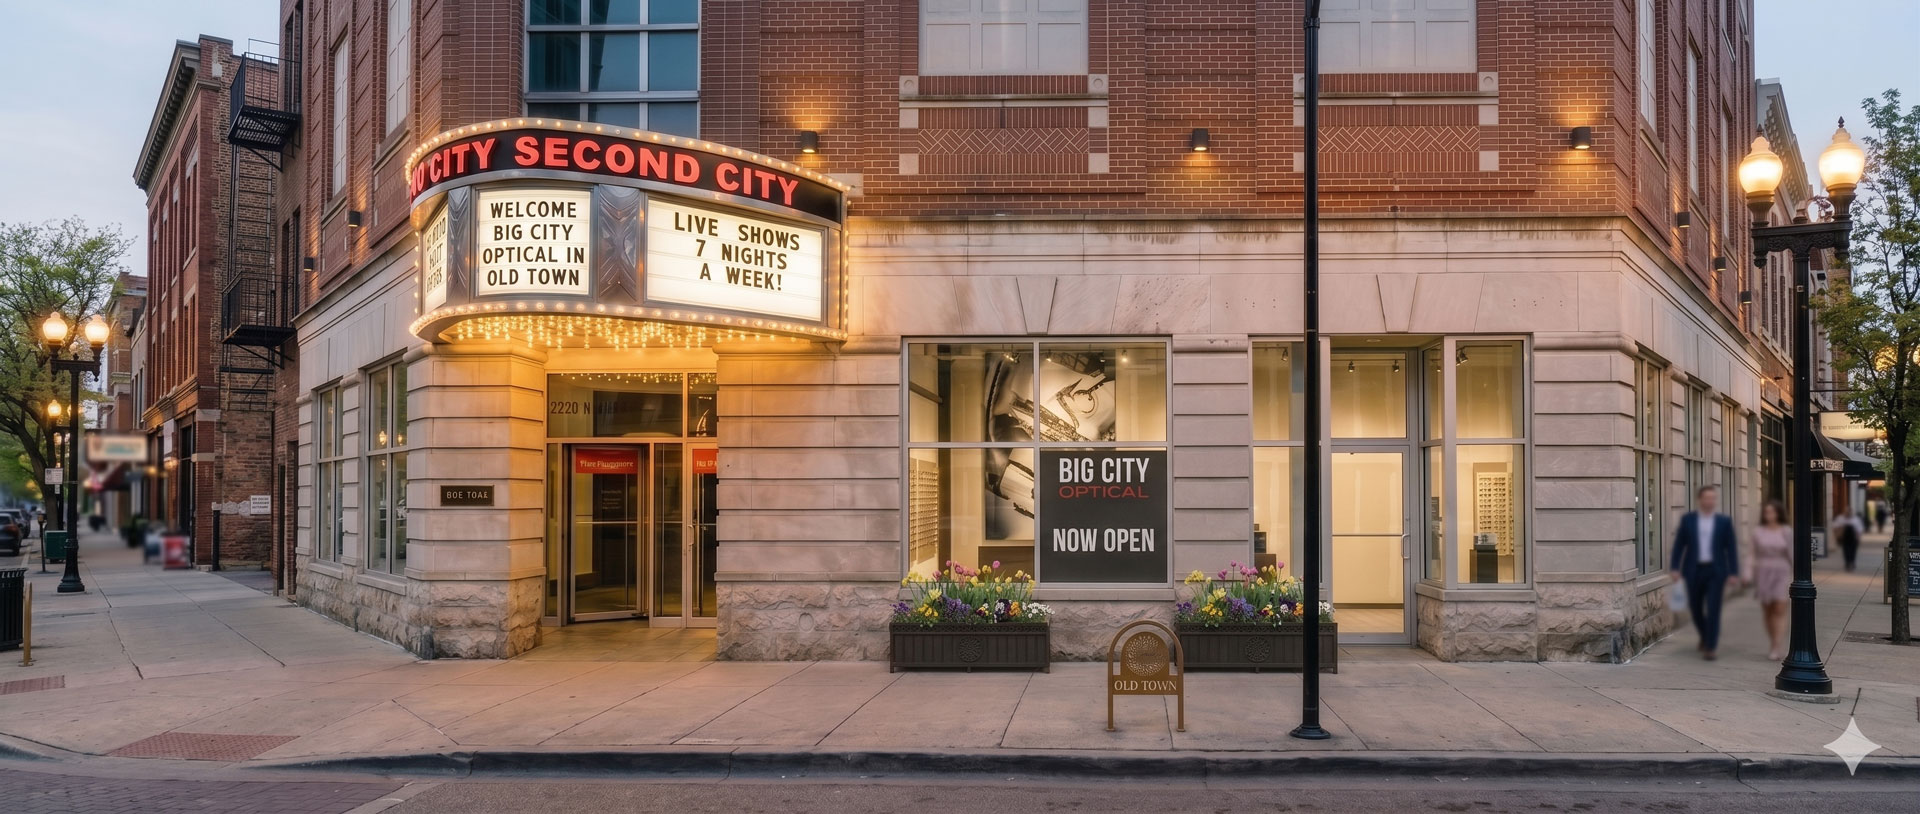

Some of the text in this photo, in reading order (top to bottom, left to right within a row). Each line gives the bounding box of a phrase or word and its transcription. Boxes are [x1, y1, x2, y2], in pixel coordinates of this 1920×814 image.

[430, 138, 496, 183] CITY
[514, 136, 700, 183] SECOND
[715, 162, 799, 206] CITY
[490, 201, 577, 219] WELCOME
[494, 224, 574, 241] BIG CITY
[674, 211, 800, 251] LIVE SHOWS
[482, 246, 585, 264] OPTICAL IN
[696, 238, 787, 270] 7 NIGHTS
[487, 268, 580, 286] OLD TOWN
[699, 262, 782, 291] A WEEK!
[550, 401, 579, 415] 2220
[583, 401, 591, 415] N
[1059, 457, 1150, 483] BIG CITY
[1059, 485, 1149, 499] OPTICAL
[1053, 528, 1155, 552] NOW OPEN
[1114, 680, 1177, 691] OLD TOWN
